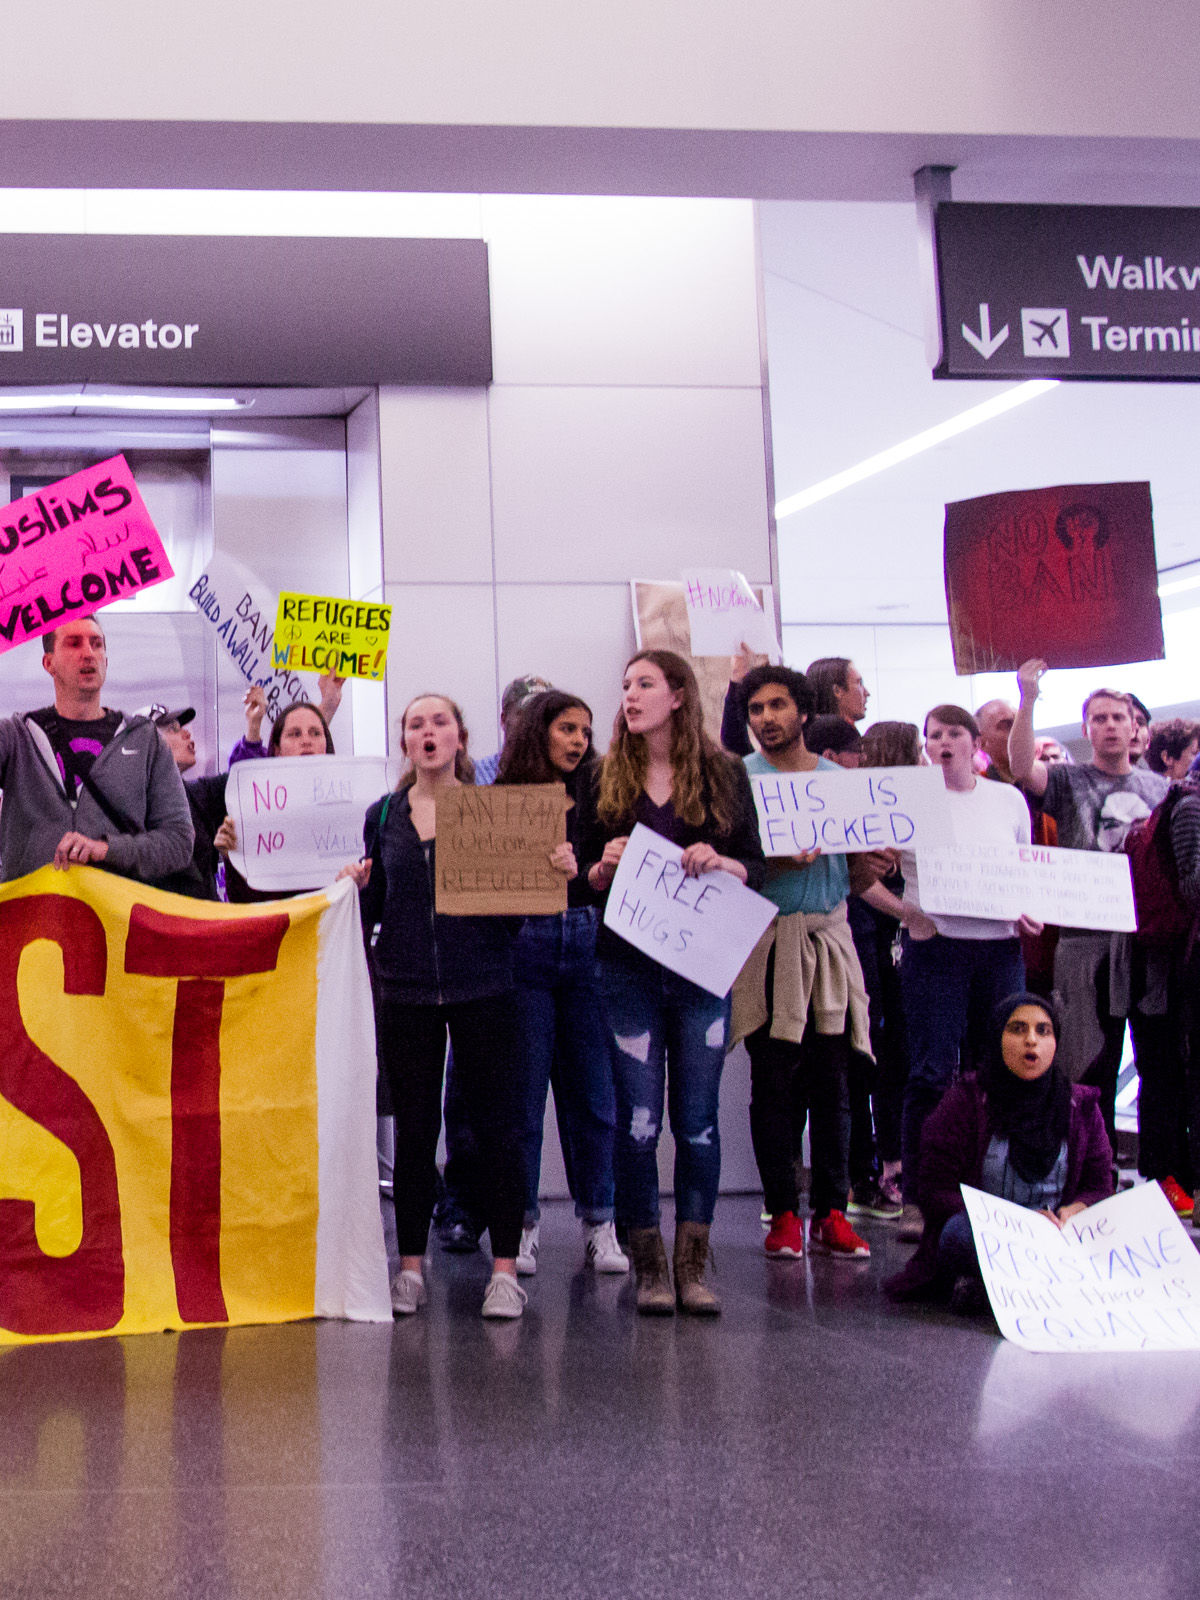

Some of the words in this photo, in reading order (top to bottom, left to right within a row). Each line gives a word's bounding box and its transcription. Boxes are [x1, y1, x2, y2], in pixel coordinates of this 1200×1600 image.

[36, 314, 199, 349] Elevator
[988, 549, 1112, 610] BAN
[283, 599, 392, 631] REFUGEES
[315, 631, 351, 645] ARE
[274, 643, 385, 676] WELCOME!
[253, 780, 287, 814] NO
[313, 777, 352, 803] BAN
[868, 776, 898, 806] IS
[257, 831, 285, 855] NO
[766, 812, 915, 852] FUCKED
[1018, 849, 1056, 865] EVIL
[636, 849, 722, 914] FREE
[619, 889, 693, 951] HUGS
